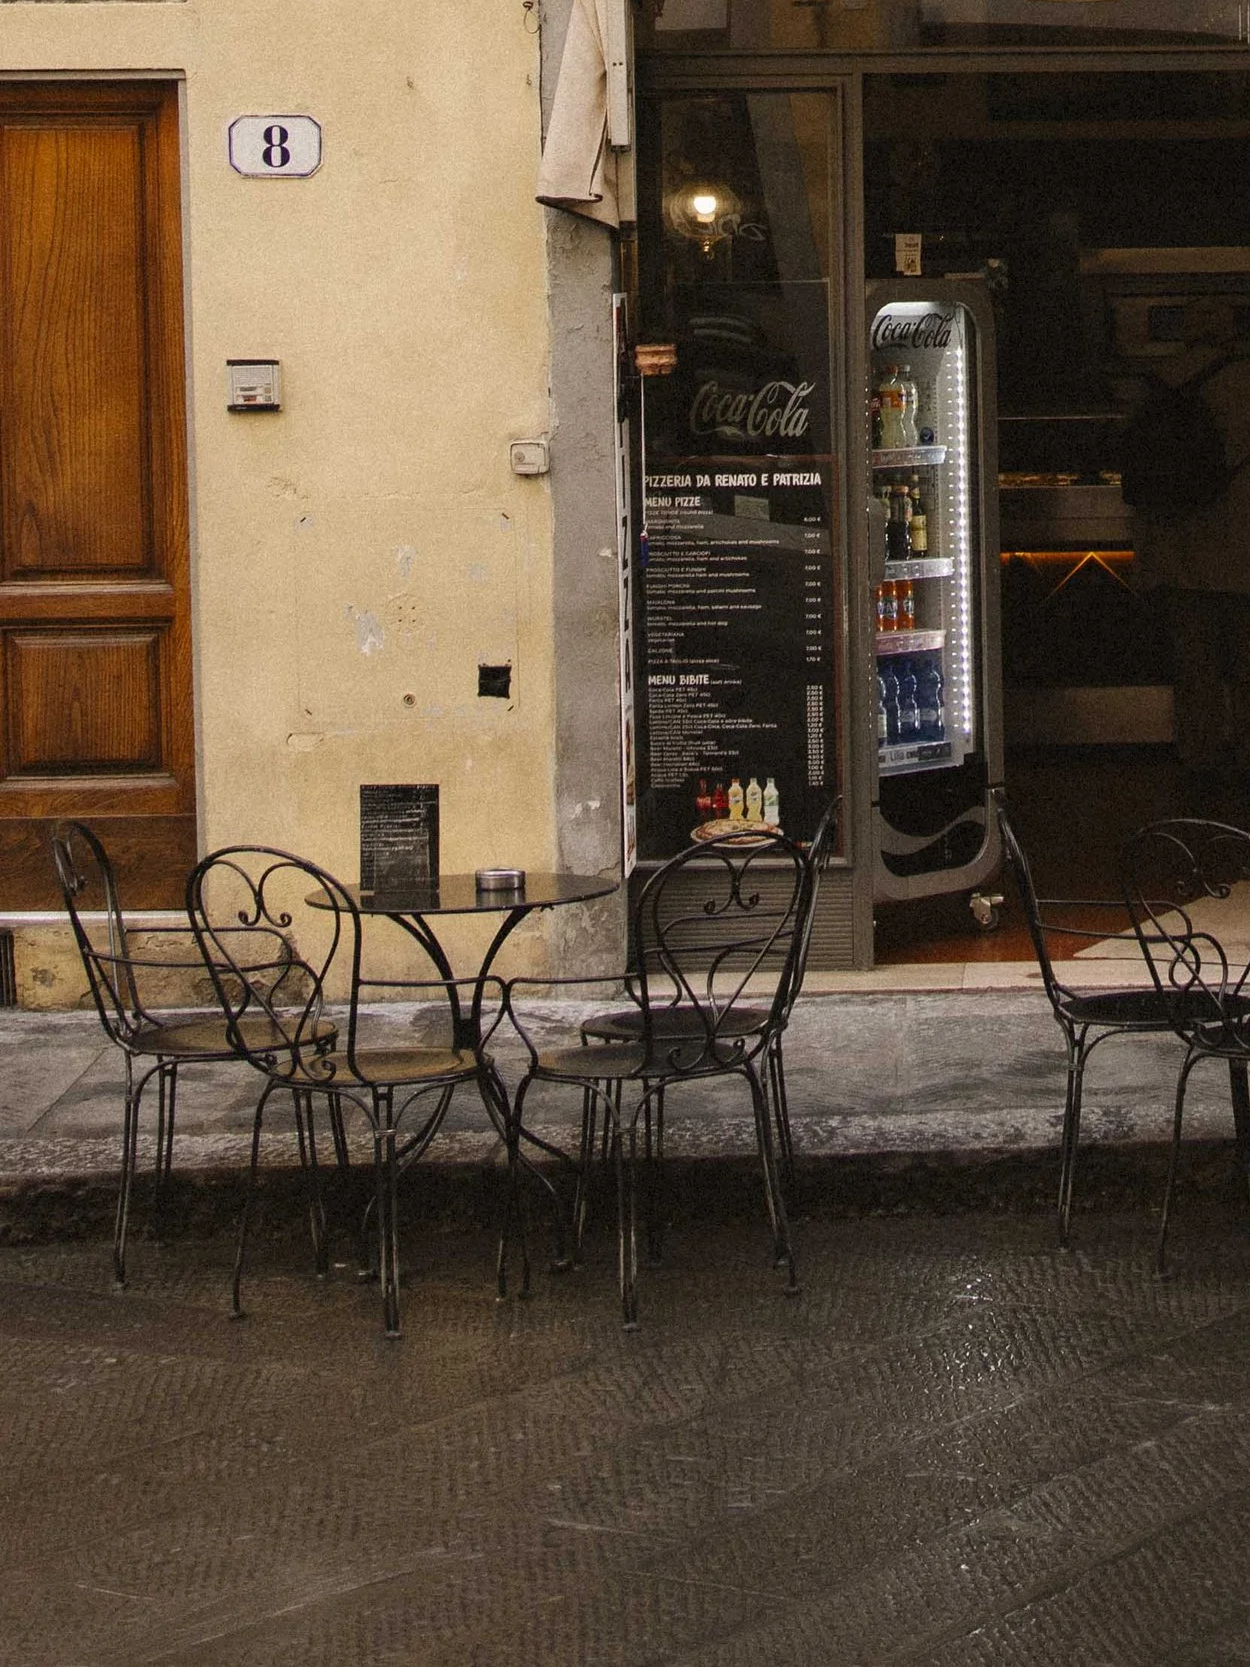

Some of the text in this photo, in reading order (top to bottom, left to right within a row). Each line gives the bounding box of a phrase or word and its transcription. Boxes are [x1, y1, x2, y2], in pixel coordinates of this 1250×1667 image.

[262, 125, 291, 168] 8
[644, 472, 822, 488] PIZZERIA DA RENATO E PATRIZIA
[645, 495, 701, 508] MENU PIZZE
[648, 674, 676, 686] MENU
[679, 673, 710, 686] BIBITE
